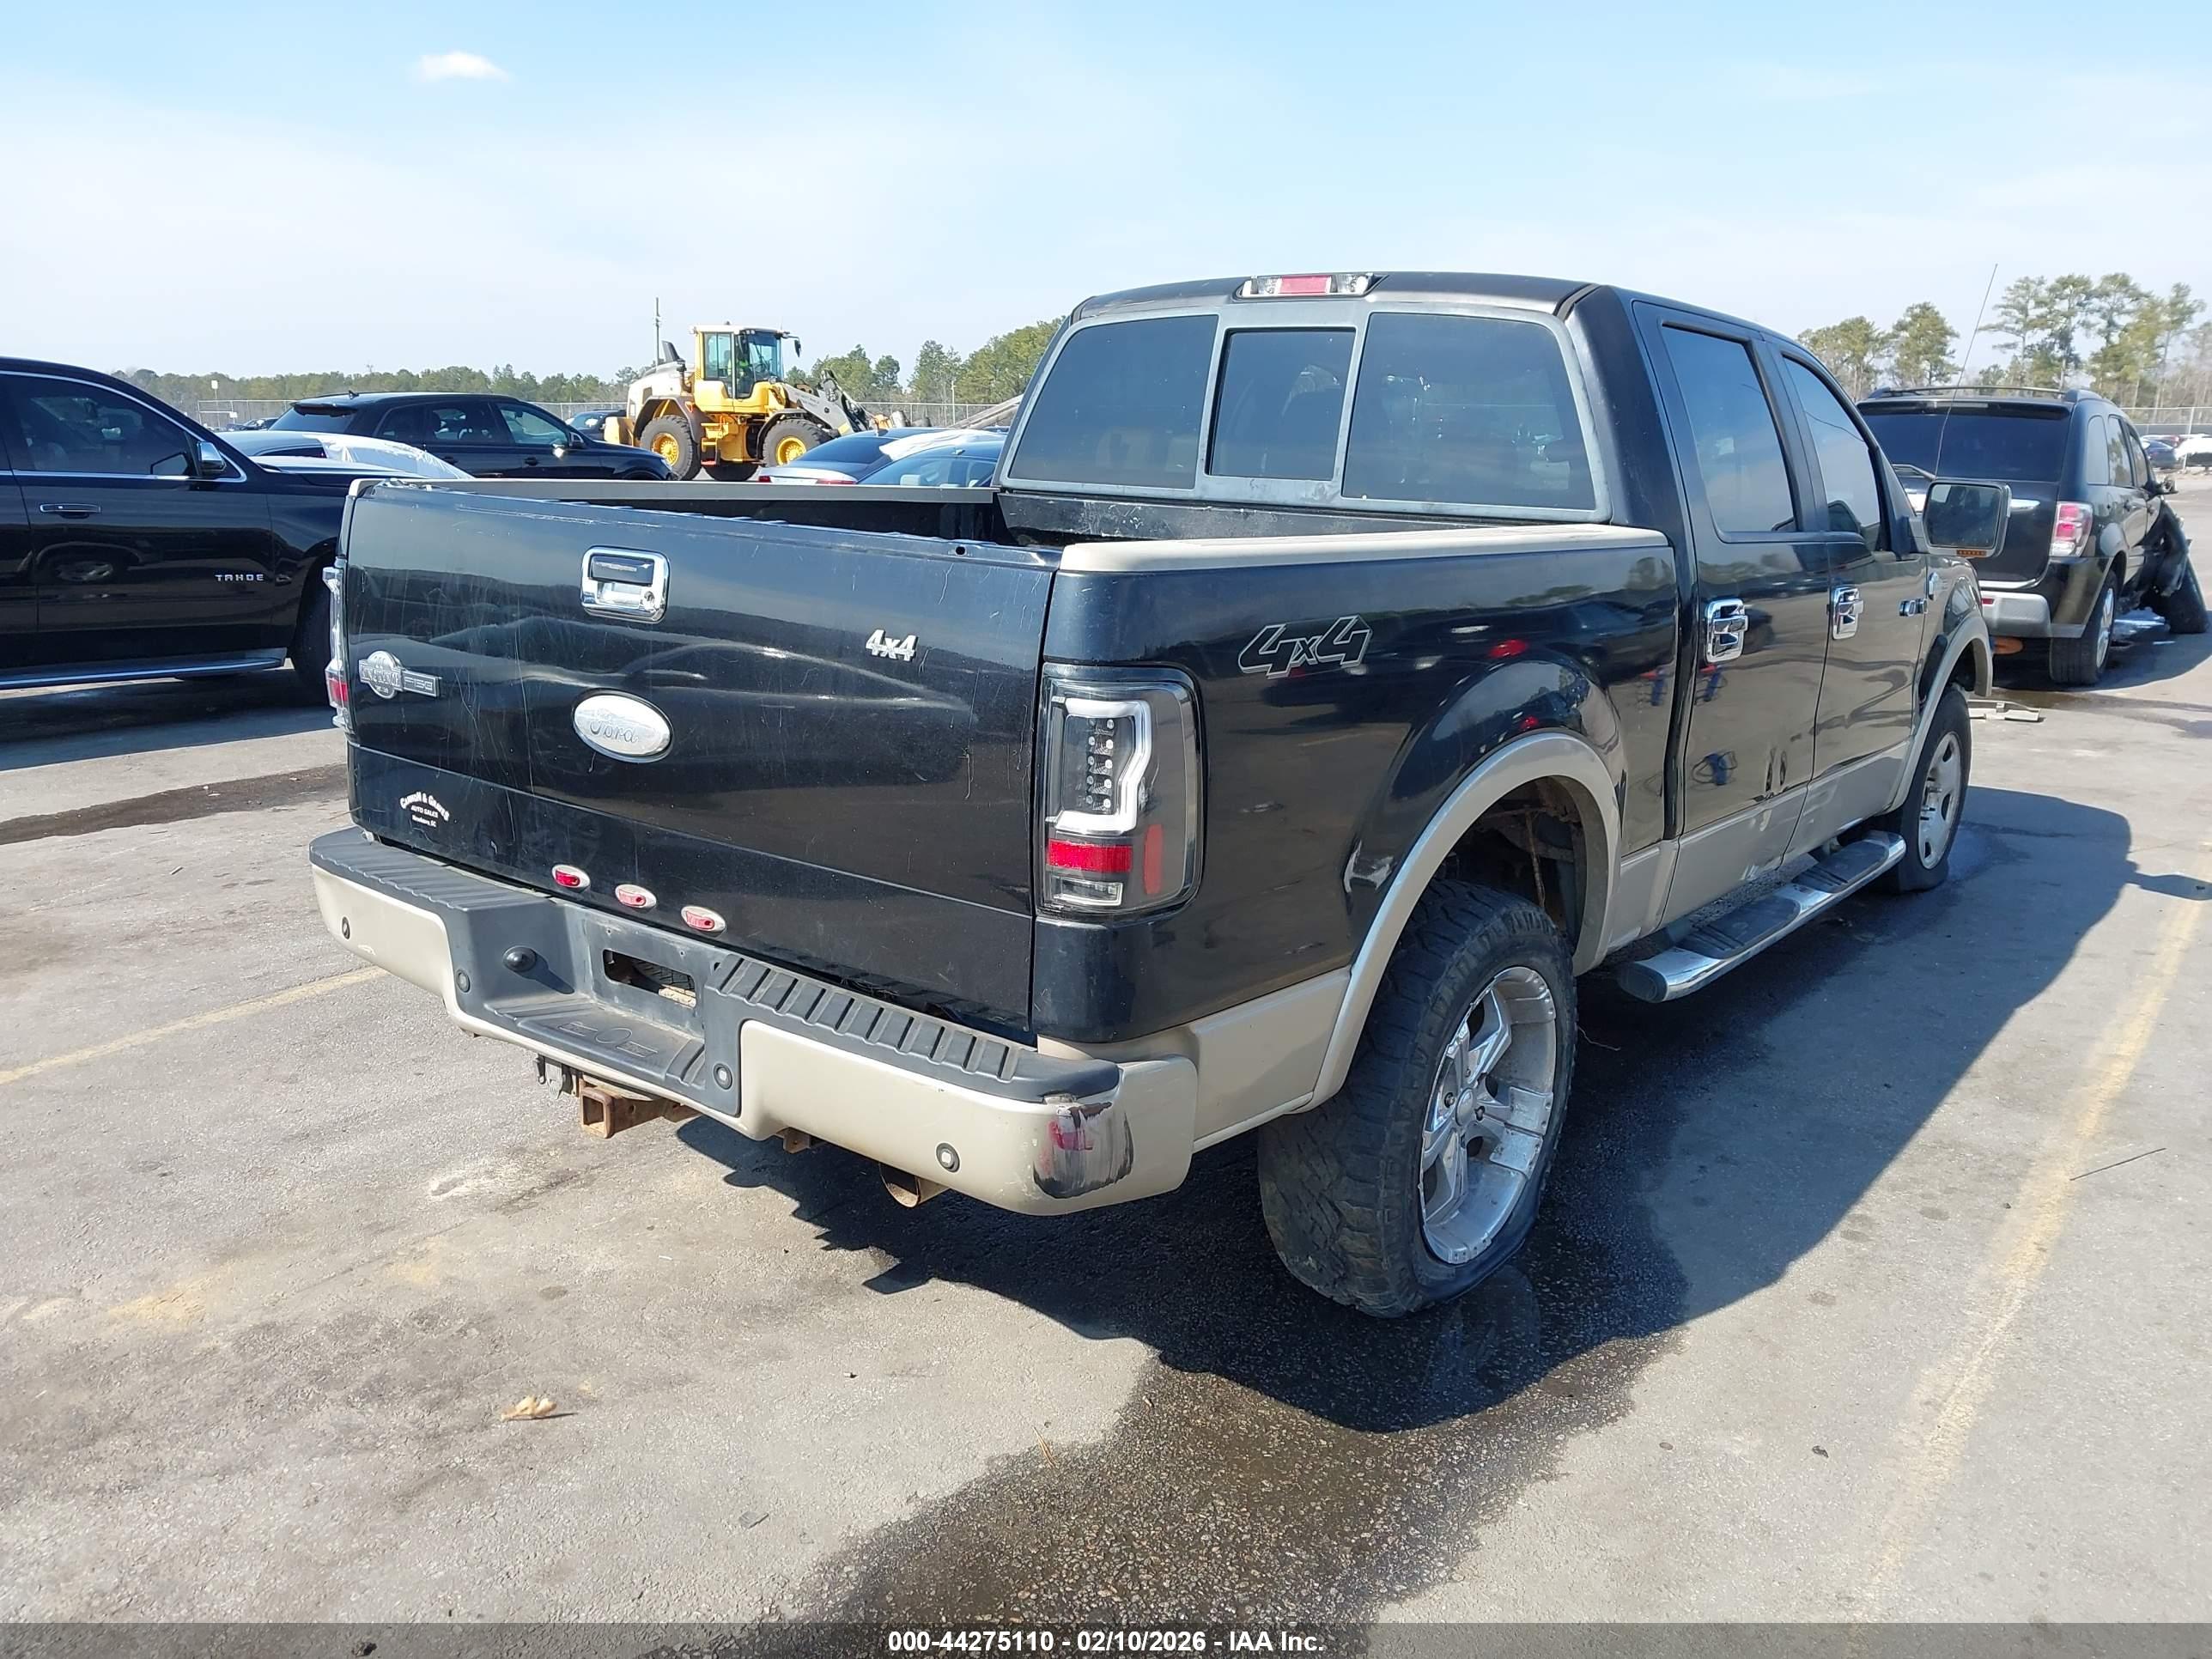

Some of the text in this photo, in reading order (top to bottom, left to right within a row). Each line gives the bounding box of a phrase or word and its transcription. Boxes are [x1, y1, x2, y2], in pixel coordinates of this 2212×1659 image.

[214, 574, 264, 582] TAHOE
[866, 629, 917, 661] 4x4
[1237, 614, 1372, 679] 4x4
[589, 710, 639, 744] Ford
[424, 809, 438, 818] SALES
